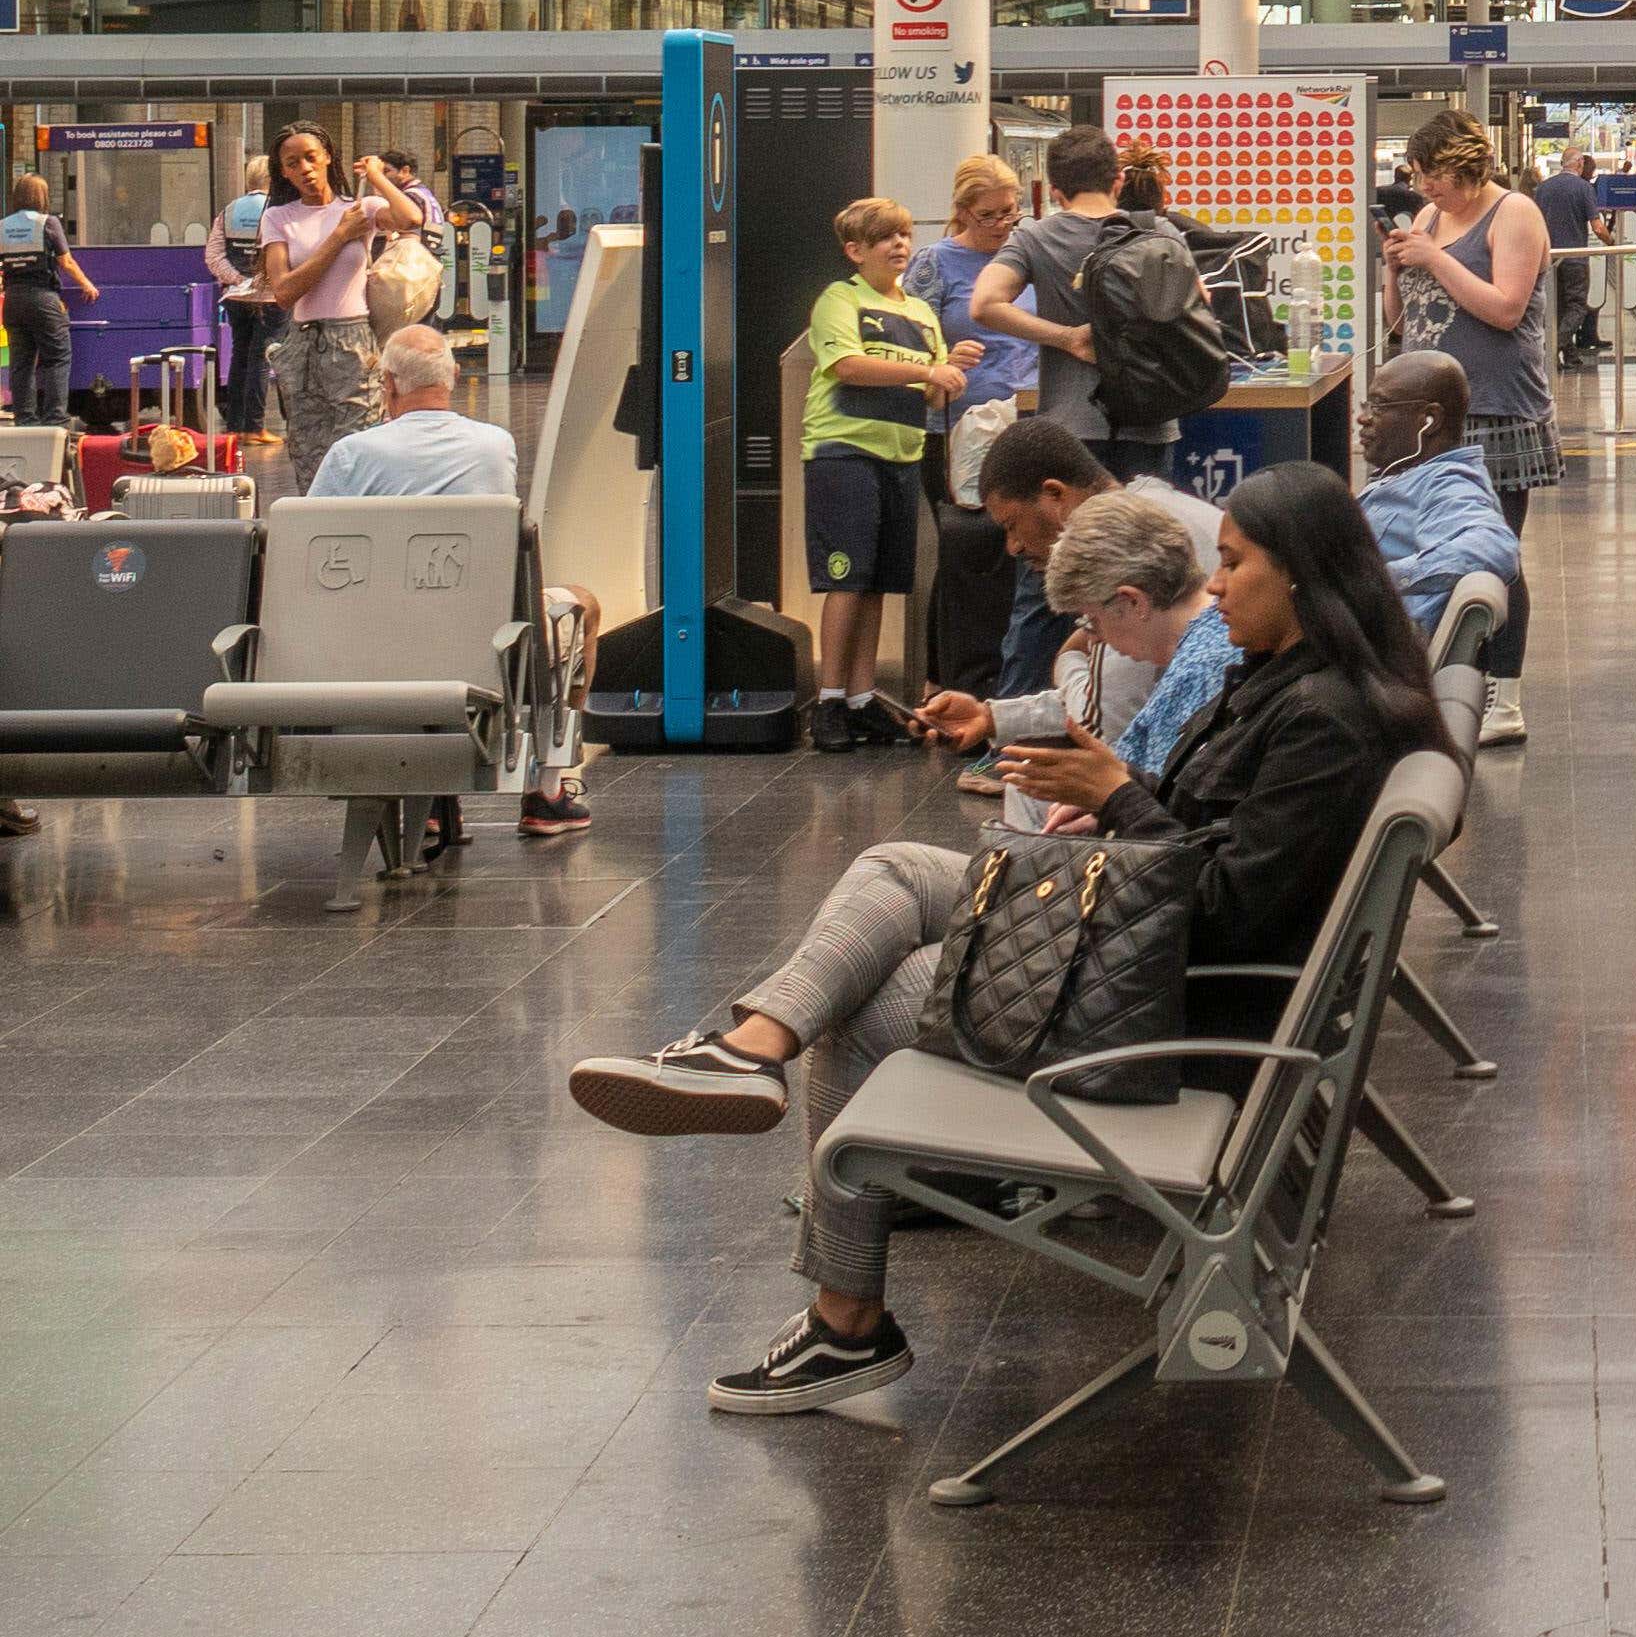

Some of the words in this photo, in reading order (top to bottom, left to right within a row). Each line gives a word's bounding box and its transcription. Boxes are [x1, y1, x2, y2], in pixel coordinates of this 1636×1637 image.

[894, 27, 906, 35] No
[908, 27, 947, 37] smoking
[916, 66, 938, 80] US
[1296, 85, 1352, 93] NetworkRail
[65, 131, 75, 139] To
[77, 131, 96, 139] book
[98, 130, 139, 138] assistance
[141, 130, 166, 139] please
[168, 129, 182, 137] call
[95, 140, 116, 148] 0800
